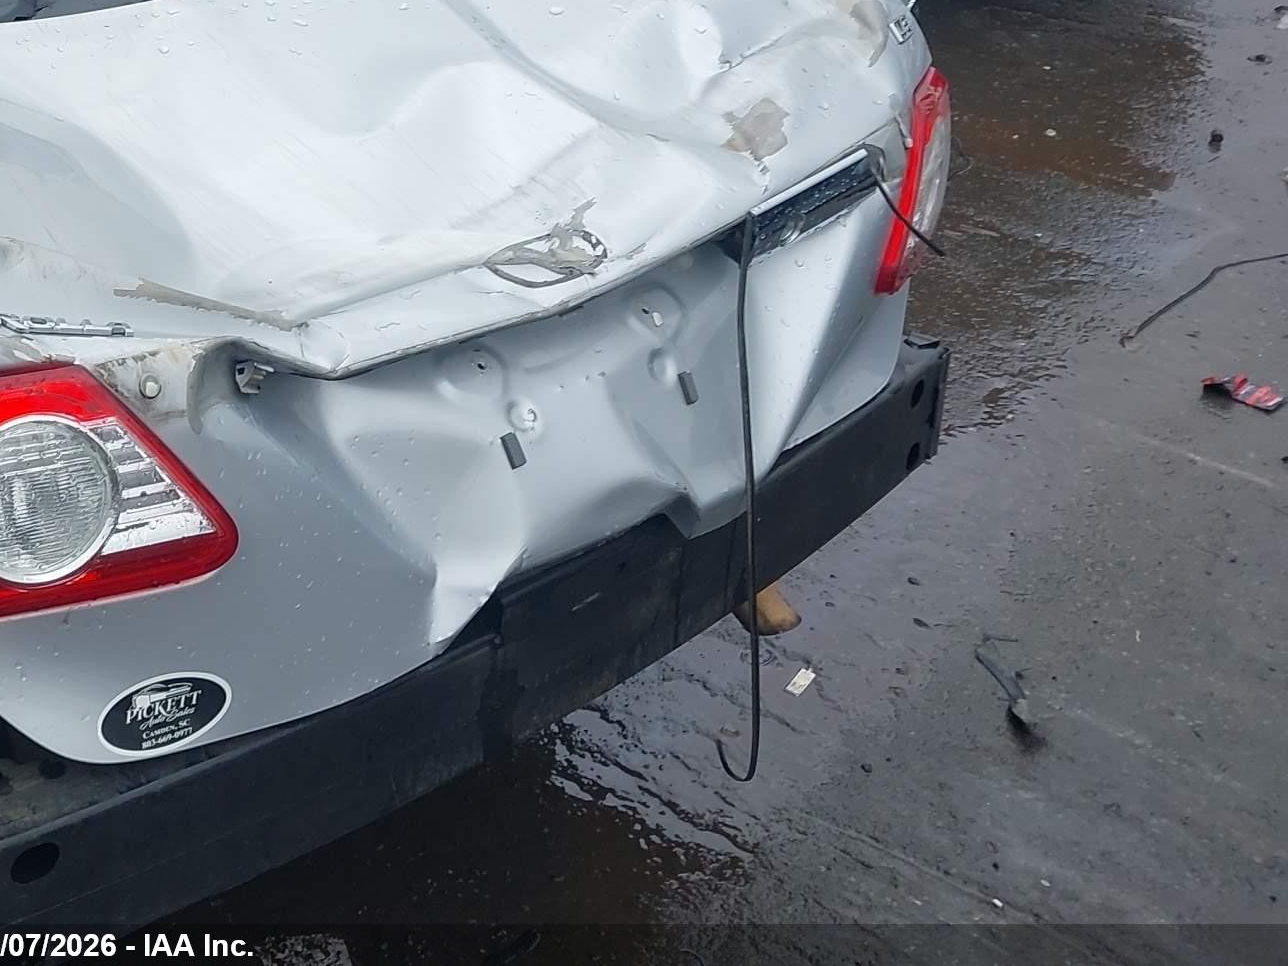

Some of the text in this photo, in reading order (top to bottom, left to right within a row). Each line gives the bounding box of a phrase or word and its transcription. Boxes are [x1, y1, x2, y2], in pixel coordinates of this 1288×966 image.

[125, 689, 202, 725] PICKETT
[139, 706, 196, 731] Auto Sales
[178, 718, 192, 729] SC
